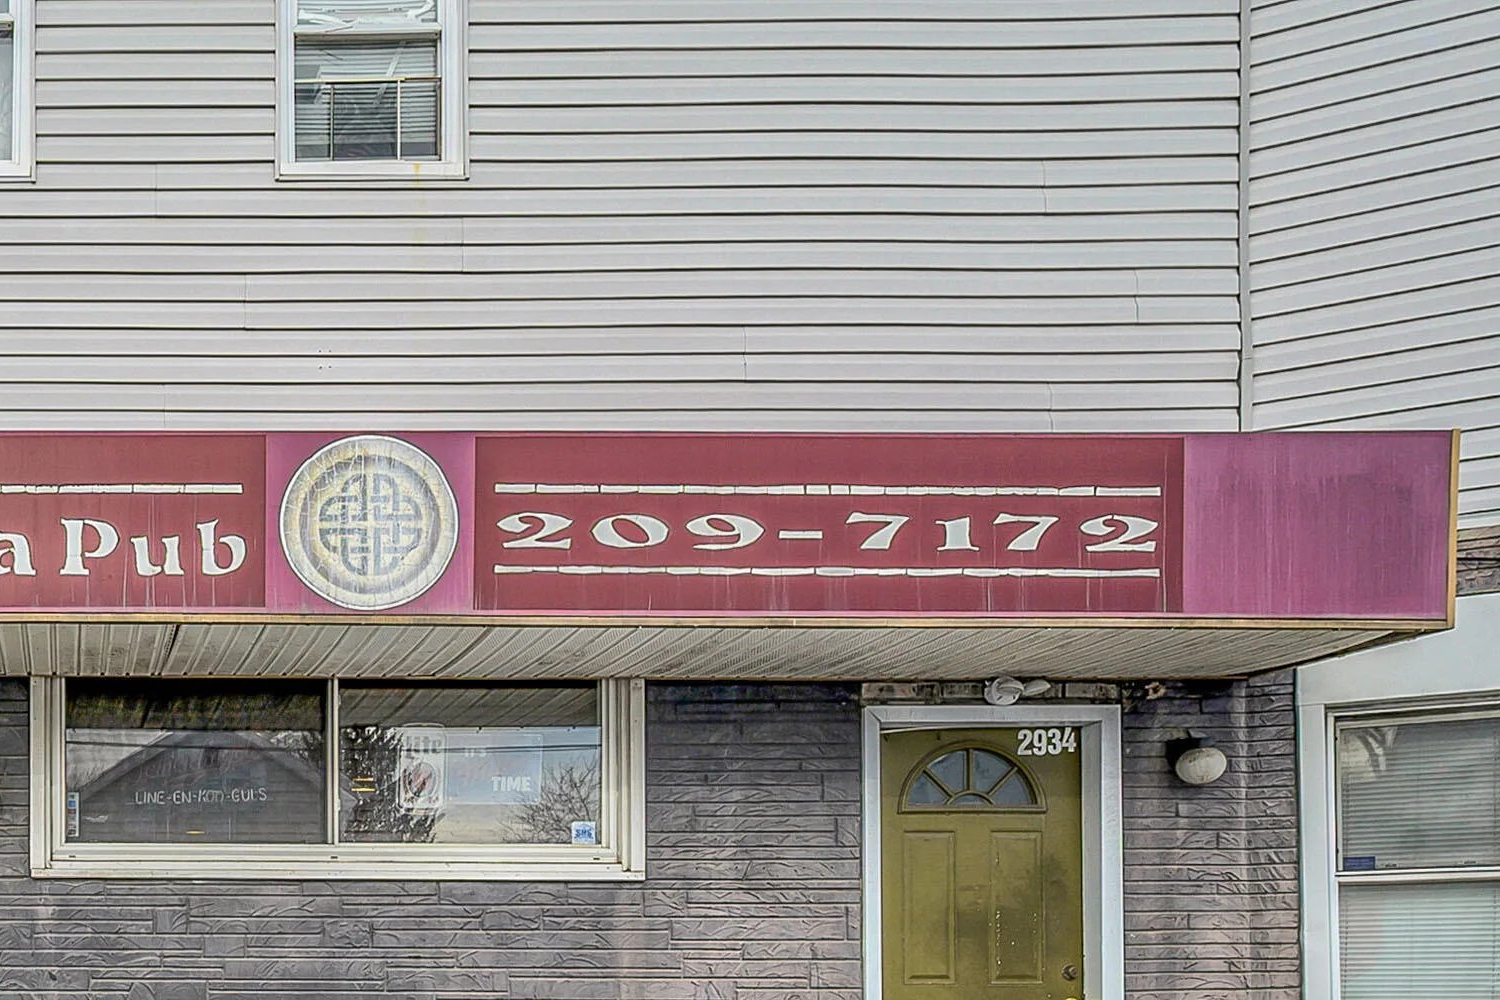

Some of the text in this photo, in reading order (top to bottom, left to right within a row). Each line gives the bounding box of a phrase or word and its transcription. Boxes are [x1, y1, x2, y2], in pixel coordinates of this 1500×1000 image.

[59, 517, 249, 578] Pub
[496, 511, 1161, 554] 209-7172
[1016, 726, 1078, 757] 2934
[490, 775, 532, 793] TIME
